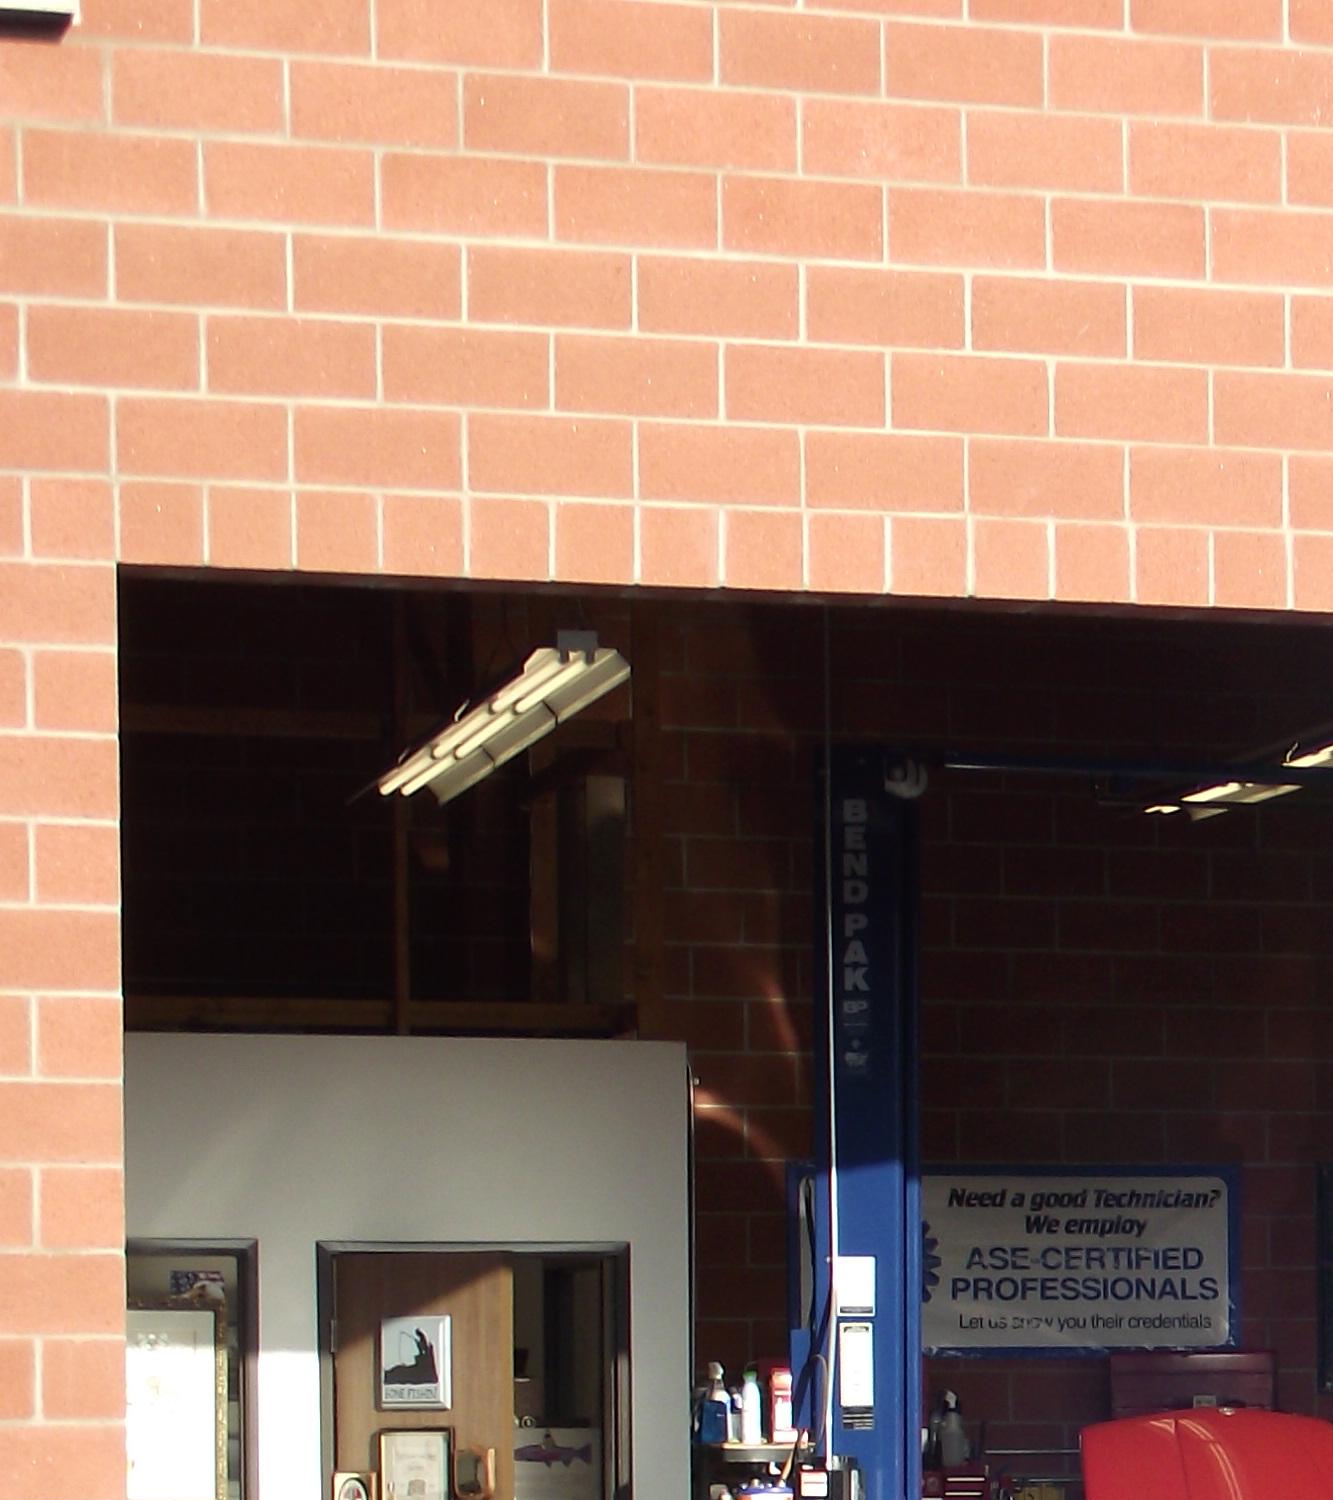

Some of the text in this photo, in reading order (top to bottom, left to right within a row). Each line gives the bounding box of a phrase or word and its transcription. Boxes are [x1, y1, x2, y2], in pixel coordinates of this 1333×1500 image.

[948, 1188, 1222, 1212] Need a good Technician?
[1025, 1215, 1147, 1238] We employ
[966, 1247, 1204, 1270] ASE-CERTIFIED
[951, 1277, 1219, 1301] PROFESSIONALS
[959, 1313, 984, 1330] Let
[989, 1316, 1007, 1330] us
[1058, 1316, 1087, 1333] you
[1091, 1313, 1123, 1330] their
[1128, 1313, 1212, 1330] credentials
